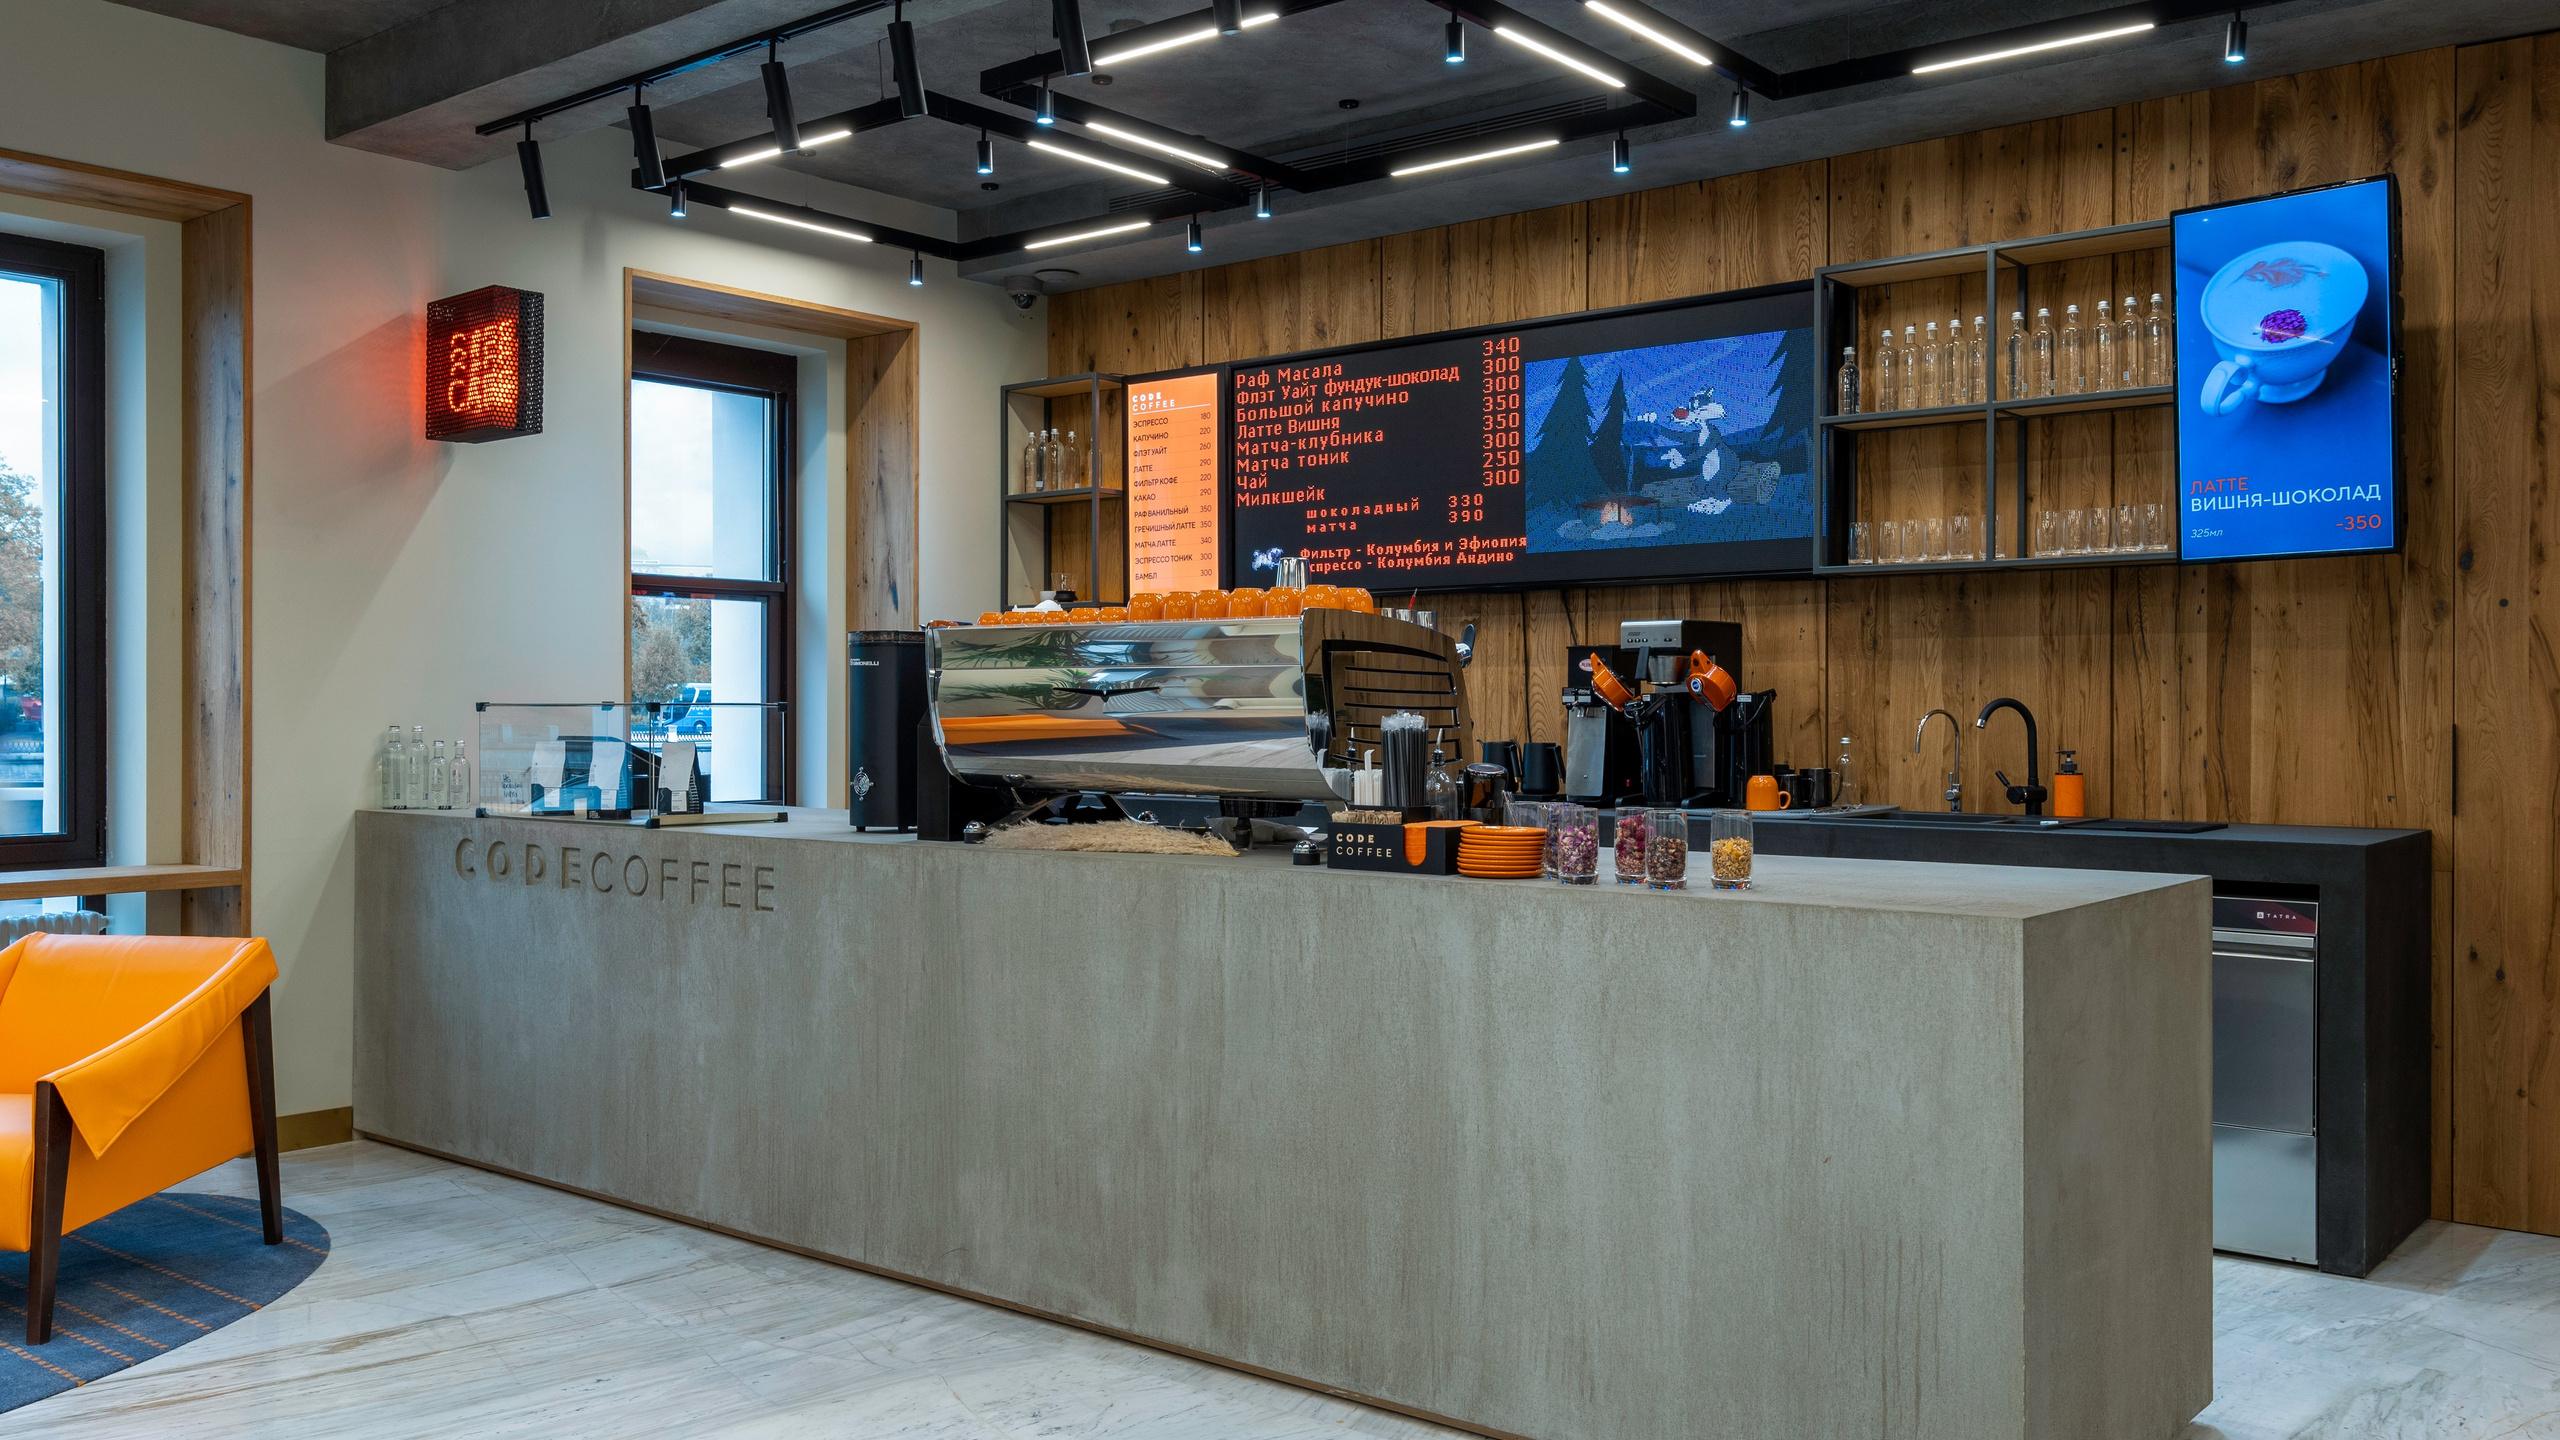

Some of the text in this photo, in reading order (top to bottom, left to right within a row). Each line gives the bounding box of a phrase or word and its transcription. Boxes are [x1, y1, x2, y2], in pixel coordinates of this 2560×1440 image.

[1236, 336, 1520, 389] Раф Масала 340
[1236, 355, 1520, 405] Флэт Уайт фундук-шоколад 300
[1132, 392, 1161, 402] CODE
[1236, 374, 1520, 423] Большой капучино 300
[1132, 399, 1175, 412] COFFEE
[1133, 412, 1211, 428] ЭСПРЕССО 180
[1237, 393, 1520, 440] Латте Вишня 350
[1133, 427, 1211, 442] КАПУЧИНО 220
[1236, 412, 1520, 457] Матча-клубника 350
[1133, 449, 1150, 457] ФЛЭТ
[1152, 446, 1167, 455] УАЙТ
[1236, 430, 1520, 474] Матча тоник 300
[1133, 465, 1153, 473] ЛАТТЕ
[1237, 449, 1520, 490] Чай 250
[1134, 473, 1211, 487] ФИЛЬТР КОФЕ 220
[1237, 468, 1520, 508] Милкшейк 300
[2190, 477, 2249, 495] ЛАТТЕ
[1134, 488, 1211, 502] КАКАО 290
[2191, 484, 2382, 512] ВИШНЯ-ШОКОЛАД
[1148, 505, 1188, 517] ВАНИЛЬНЫЙ
[1306, 493, 1484, 519] шоколадный 330
[1135, 520, 1212, 533] ГРЕЧИШНЫЙ ЛАТТЕ 350
[1306, 509, 1484, 534] матча 390
[2336, 514, 2382, 530] -350
[2190, 528, 2223, 538] 325мл
[1135, 541, 1156, 549] МАТЧА
[1157, 539, 1176, 547] ЛАТТЕ
[1300, 547, 1351, 560] Фильтр
[1366, 539, 1439, 557] Колумбия
[1445, 542, 1453, 551] и
[1458, 536, 1527, 552] Эфиопия
[1135, 556, 1170, 564] ЭСПРЕССО
[1171, 554, 1193, 562] ТОНИК
[1309, 561, 1362, 575] спрессо
[1377, 552, 1451, 570] Колумбия
[1456, 552, 1514, 565] Андино
[1135, 569, 1212, 580] БАМБЛ 300
[1336, 833, 1374, 844] CODE
[1336, 846, 1392, 858] COFFEE
